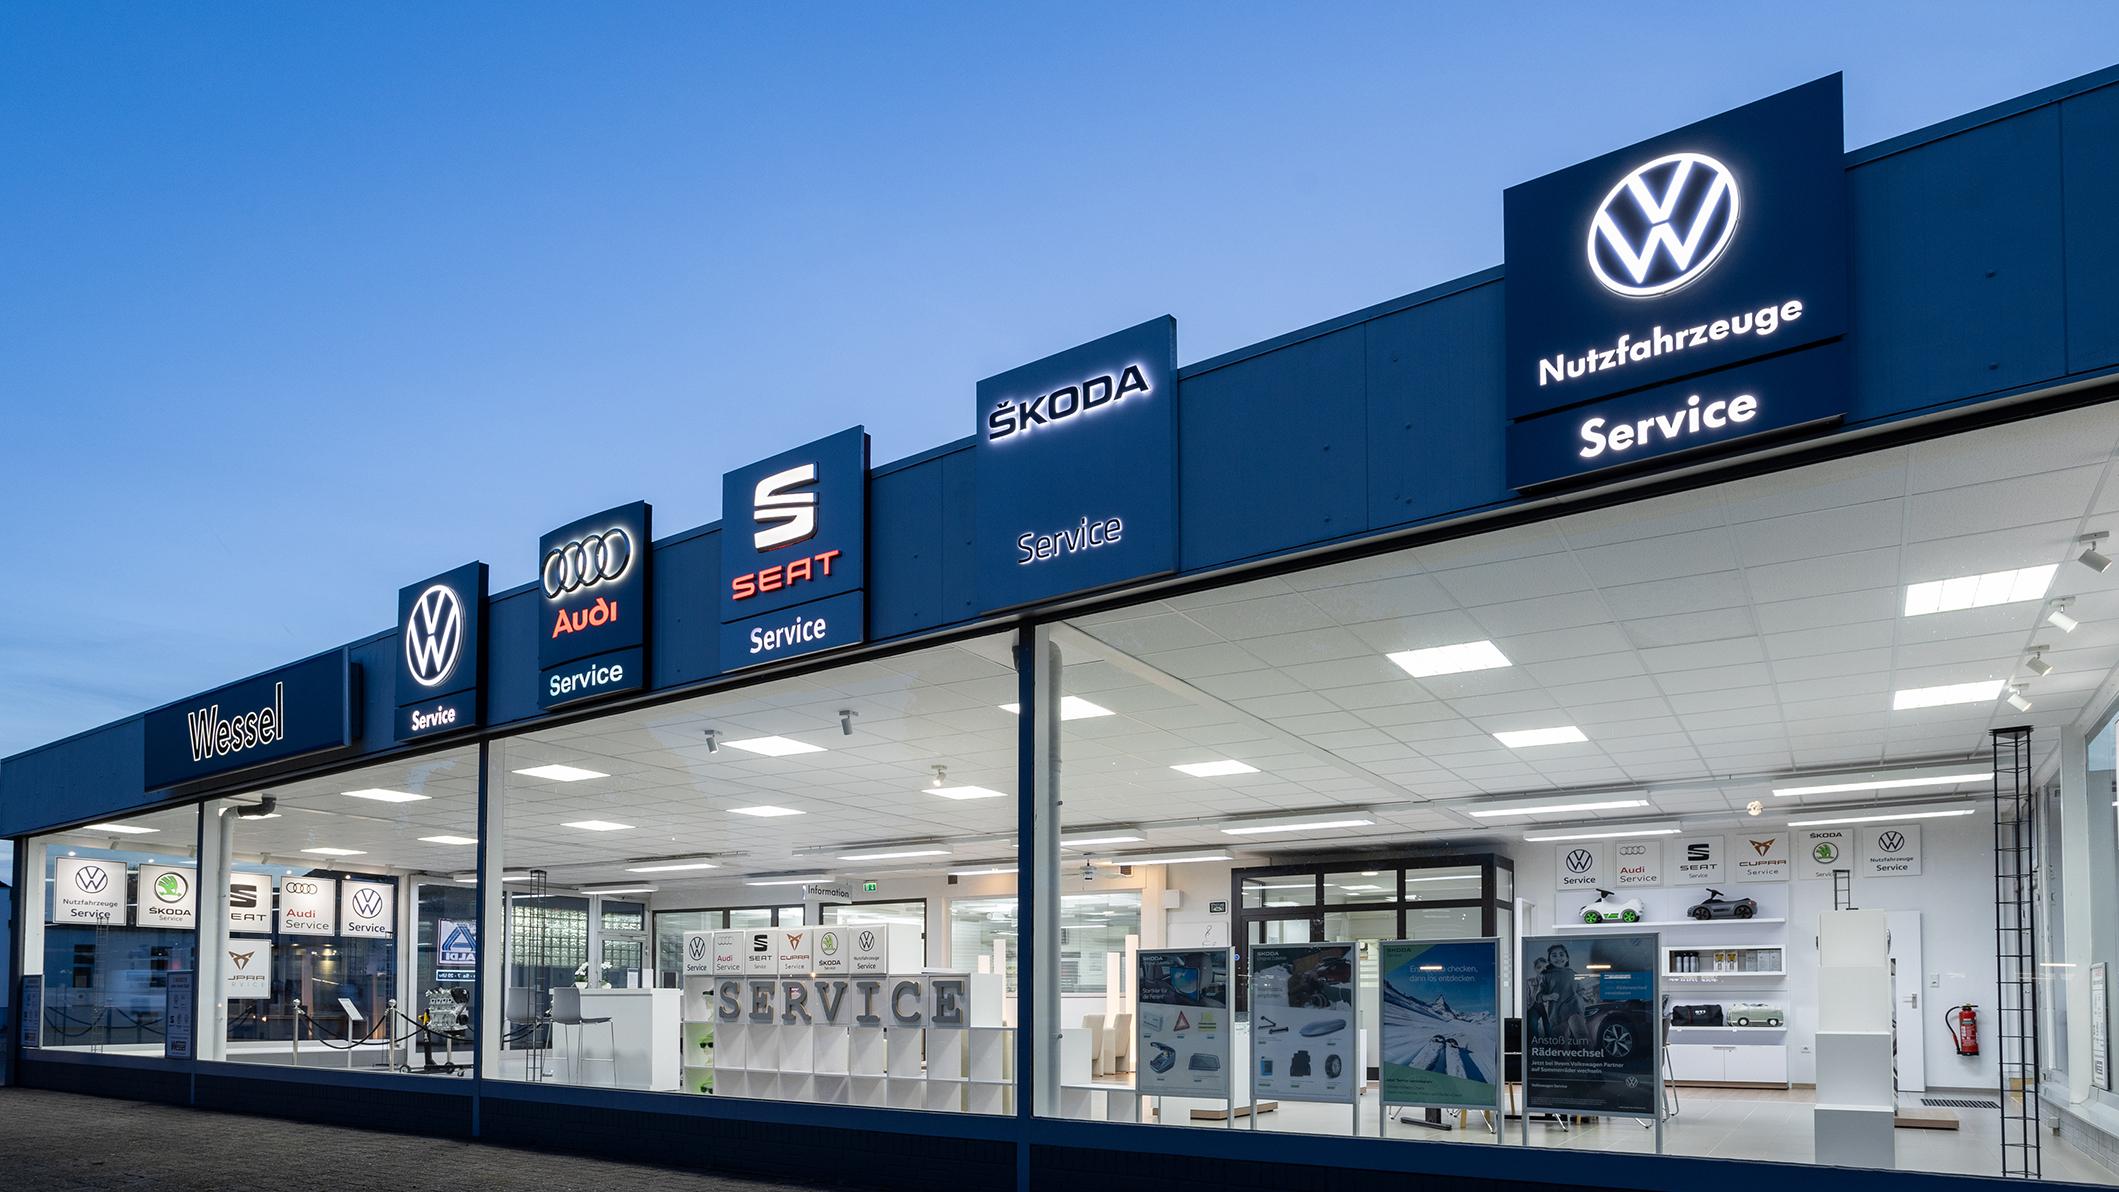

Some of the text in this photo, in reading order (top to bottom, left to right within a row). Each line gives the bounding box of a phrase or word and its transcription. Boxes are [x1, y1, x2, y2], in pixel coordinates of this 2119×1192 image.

[1538, 299, 1804, 386] Nutzfahrzeuge
[989, 364, 1150, 441] ŠKODA
[1578, 393, 1758, 459] Service
[1017, 516, 1123, 565] Service
[731, 549, 842, 601] SEAT
[551, 598, 619, 639] Audi
[749, 615, 827, 655] Service
[548, 663, 624, 697] Service
[187, 681, 284, 762] Wessel
[411, 705, 457, 731] Service
[1739, 859, 1787, 867] CUPRA
[1869, 856, 1914, 864] Nutzfahrzeuge
[1620, 866, 1645, 874] Audi
[1679, 863, 1718, 873] SEAT
[1876, 864, 1909, 872] Service
[1563, 877, 1597, 885] Service
[1619, 875, 1658, 883] Service
[807, 884, 850, 898] Information
[62, 898, 119, 908] Nutzfahrzeuge
[70, 908, 111, 919] Service
[149, 906, 192, 916] ŠKODA
[286, 908, 316, 919] Audi
[230, 912, 267, 922] EAT
[285, 919, 330, 931] Service
[348, 921, 386, 933] Service
[687, 964, 707, 972] Service
[719, 981, 964, 1024] SERVICE
[1531, 1035, 1589, 1046] Anstoß zum
[1531, 1047, 1605, 1058] Räderwechsel
